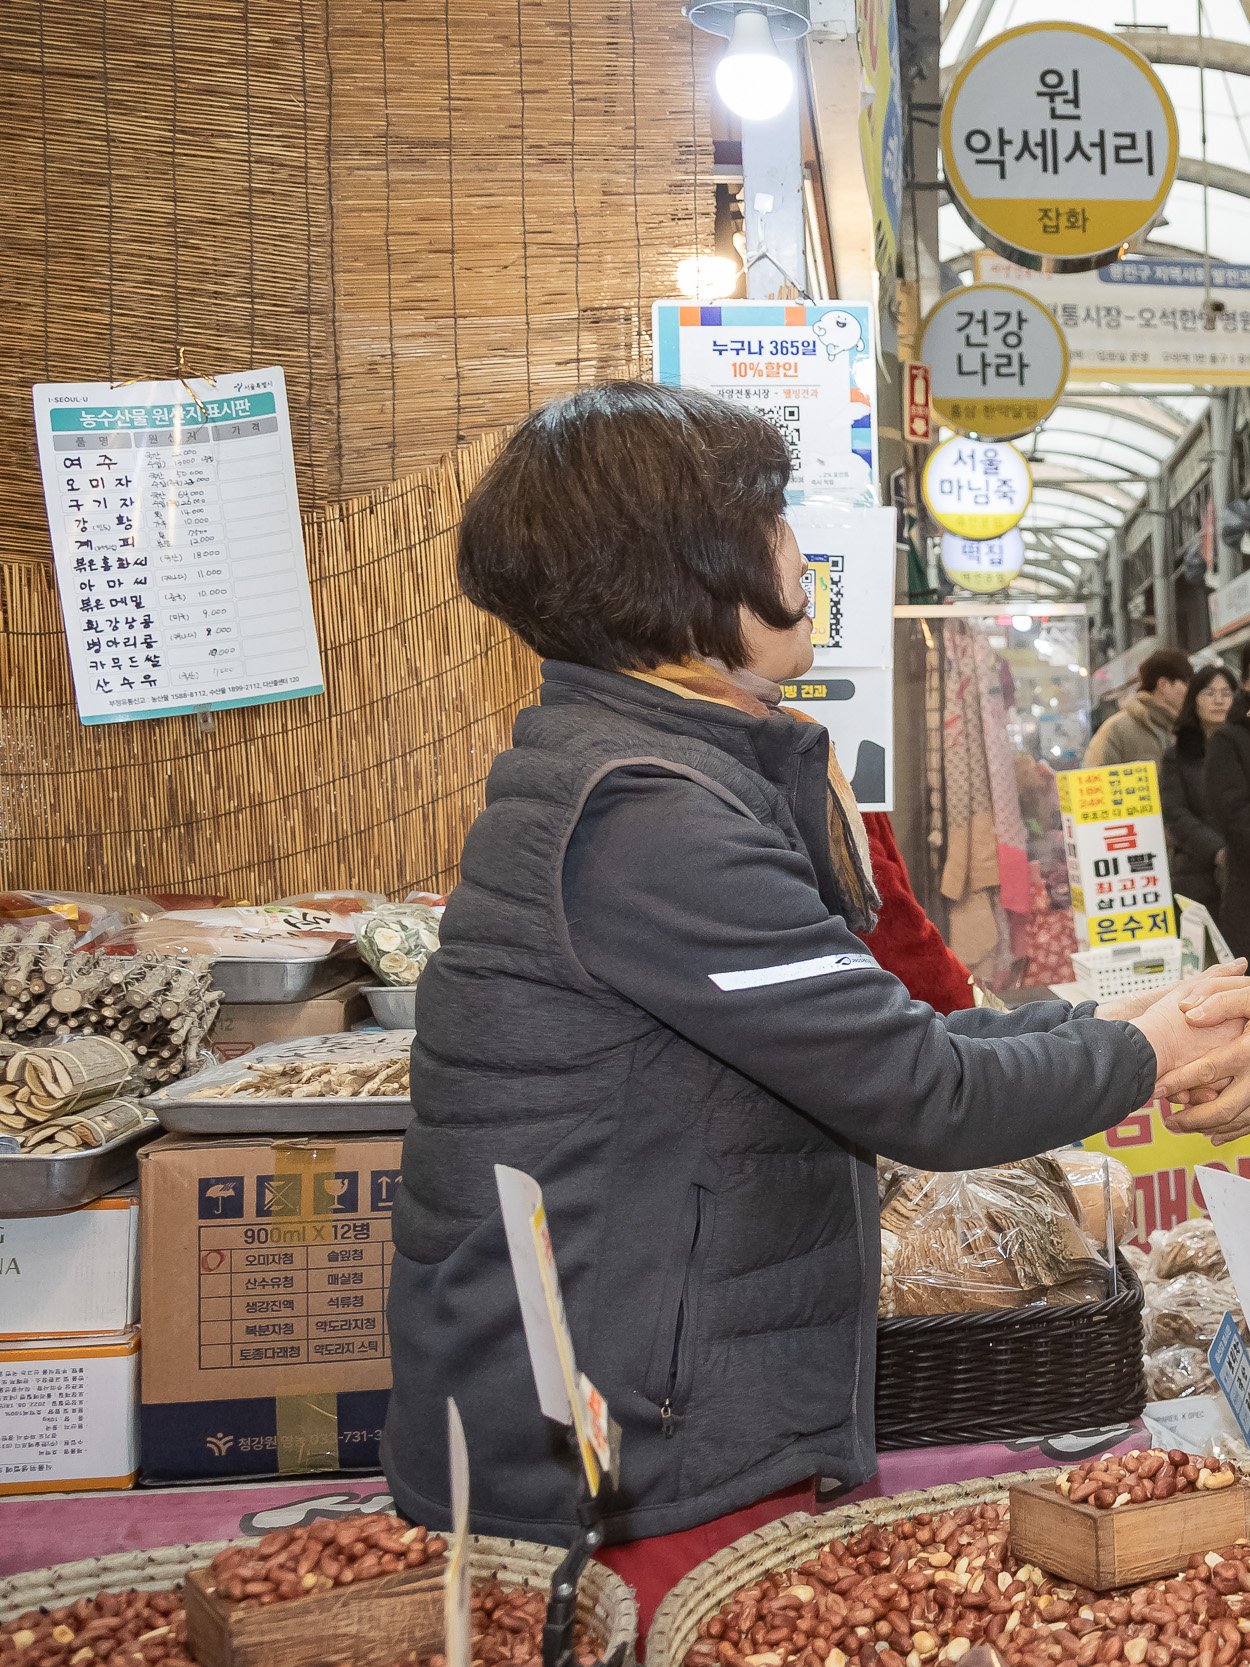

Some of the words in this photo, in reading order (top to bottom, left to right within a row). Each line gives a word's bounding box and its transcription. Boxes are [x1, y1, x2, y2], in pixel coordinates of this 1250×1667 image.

[1036, 68, 1082, 120] 원
[964, 127, 1154, 180] 악세서리
[1038, 207, 1089, 234] 잡화
[956, 309, 1028, 349] 건강
[713, 340, 763, 356] 누구나
[770, 340, 816, 356] 365일
[956, 351, 1030, 387] 나라
[244, 382, 272, 391] 서울특별시
[80, 409, 148, 428] 농수산물
[152, 404, 201, 424] 원산지
[208, 399, 251, 418] 표시판
[954, 448, 1002, 475] 서울
[940, 478, 1016, 505] 마님죽
[801, 685, 827, 698] 견과
[1104, 824, 1138, 852] 금
[1096, 911, 1170, 943] 은수저
[244, 1227, 306, 1245] 900ml
[332, 1222, 370, 1240] 12병
[245, 1253, 294, 1266] 오미자청
[327, 1249, 363, 1262] 솔잎청
[245, 1276, 294, 1290] 산수유청
[327, 1272, 363, 1285] 매실청
[245, 1299, 294, 1313] 생강진액
[327, 1296, 364, 1308] 석류청
[245, 1323, 294, 1337] 복분자청
[315, 1317, 376, 1332] 약도라지청
[240, 1346, 300, 1360] 토종다래청
[314, 1343, 355, 1356] 약도라지
[358, 1341, 378, 1352] 스틱
[238, 1436, 277, 1451] 청강원
